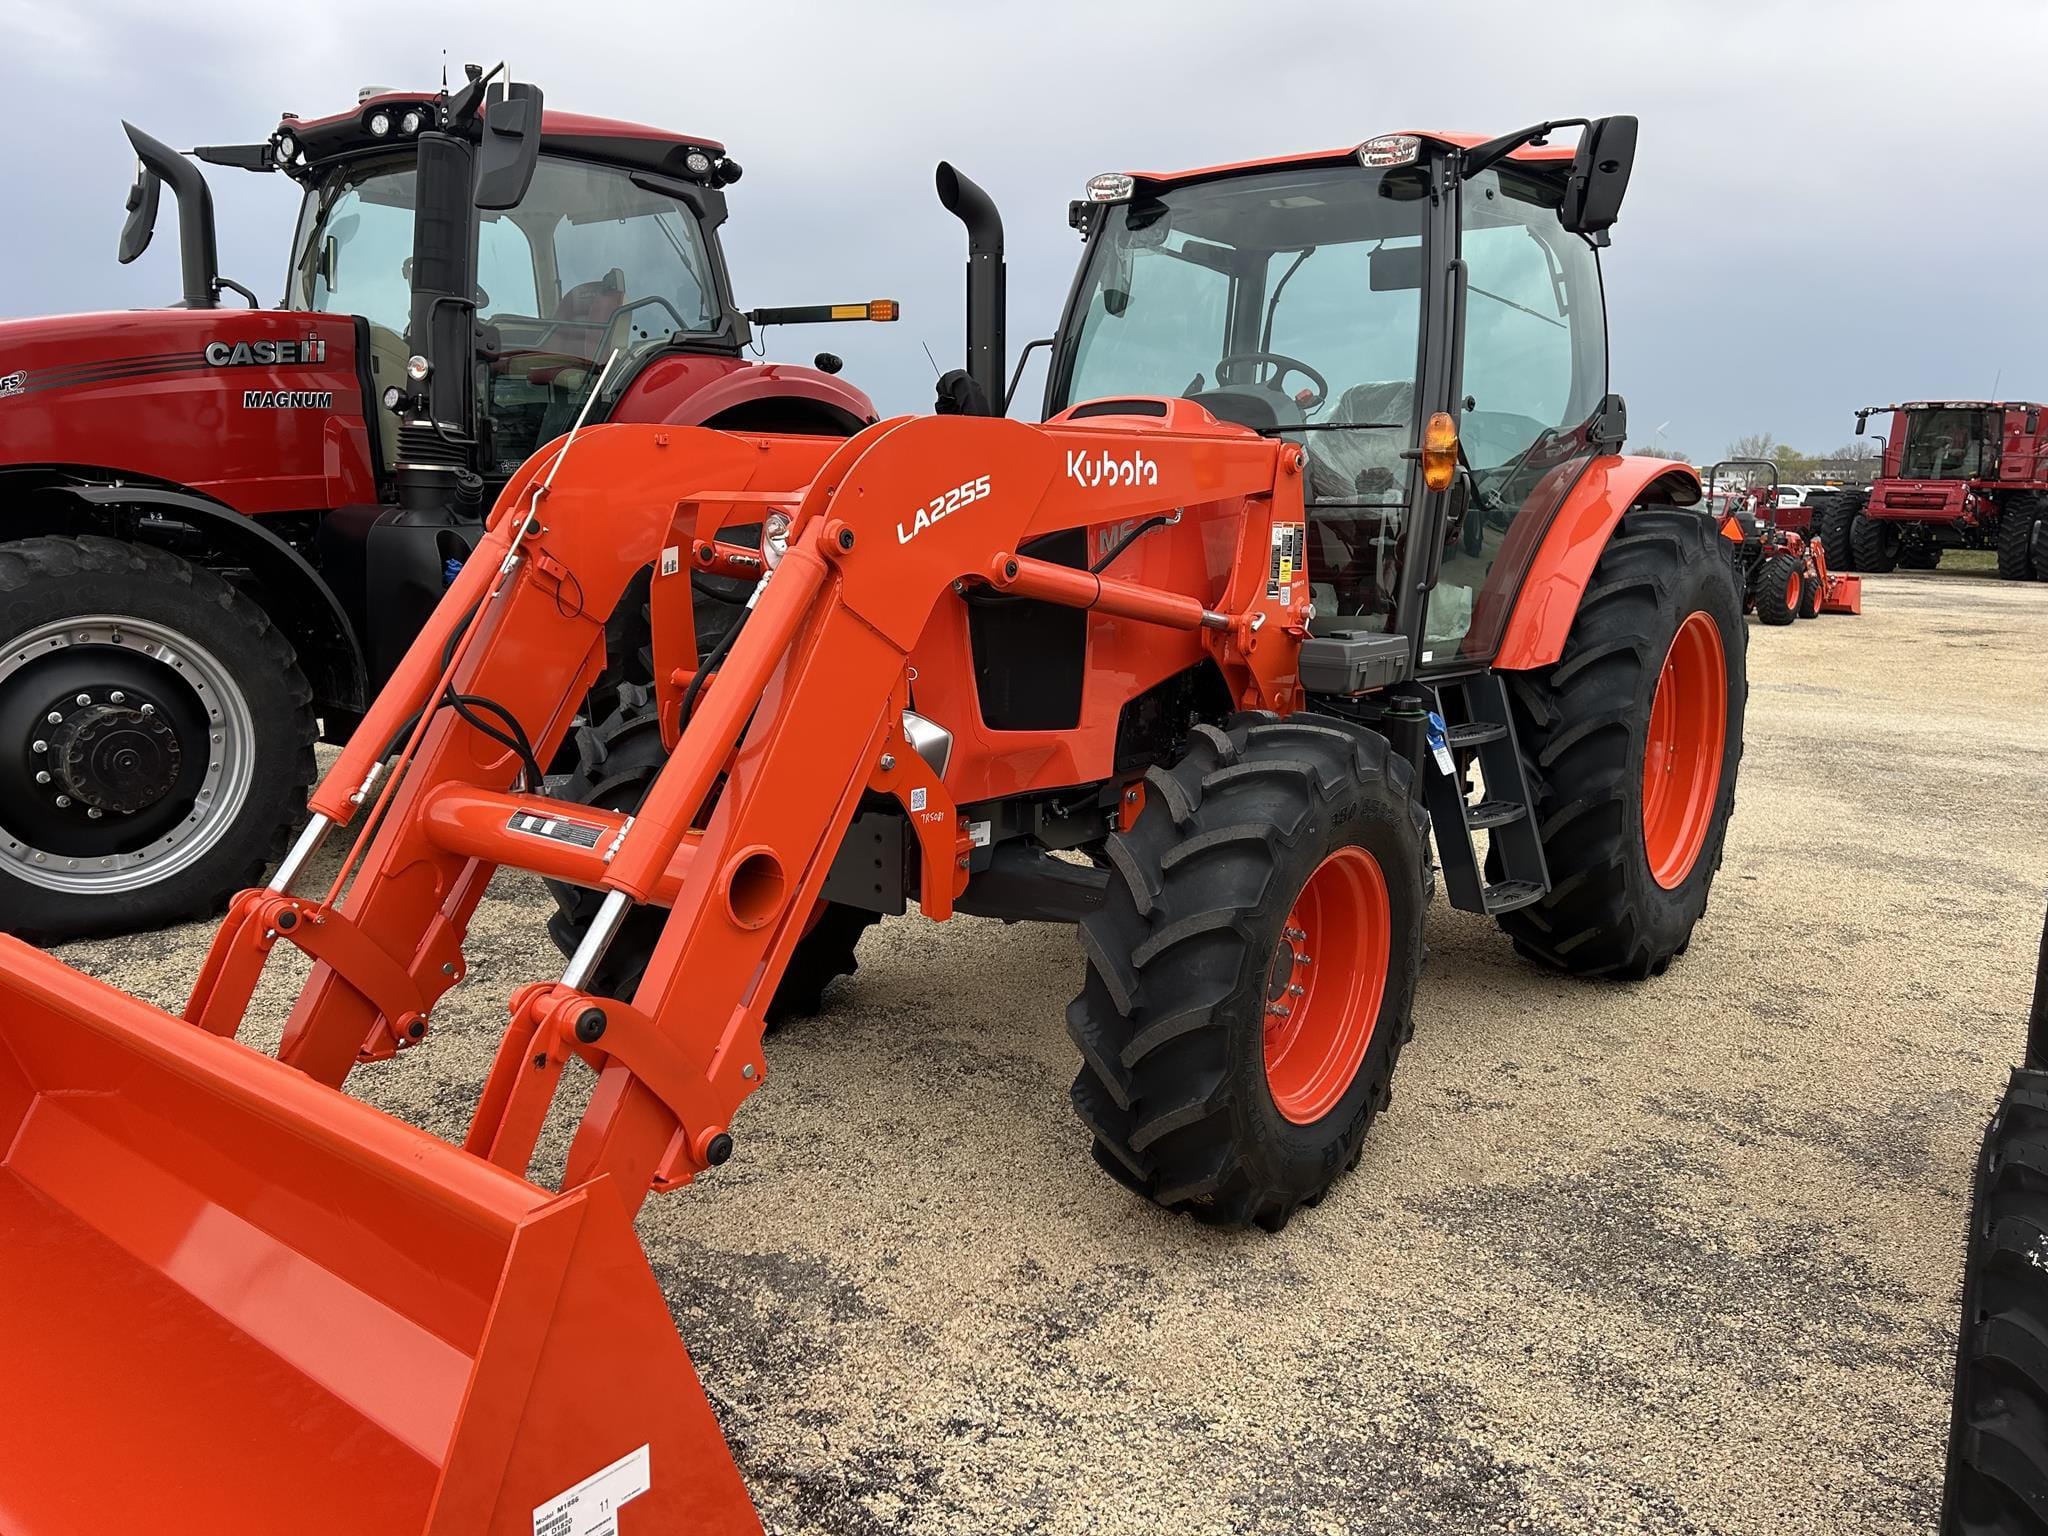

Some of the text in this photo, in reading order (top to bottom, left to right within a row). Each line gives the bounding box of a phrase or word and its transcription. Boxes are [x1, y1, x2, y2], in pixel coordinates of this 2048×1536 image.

[205, 340, 296, 366] CASE
[0, 376, 18, 391] FS
[243, 390, 332, 409] MAGNUM
[1066, 449, 1158, 488] Kubota
[896, 474, 991, 545] LA2255
